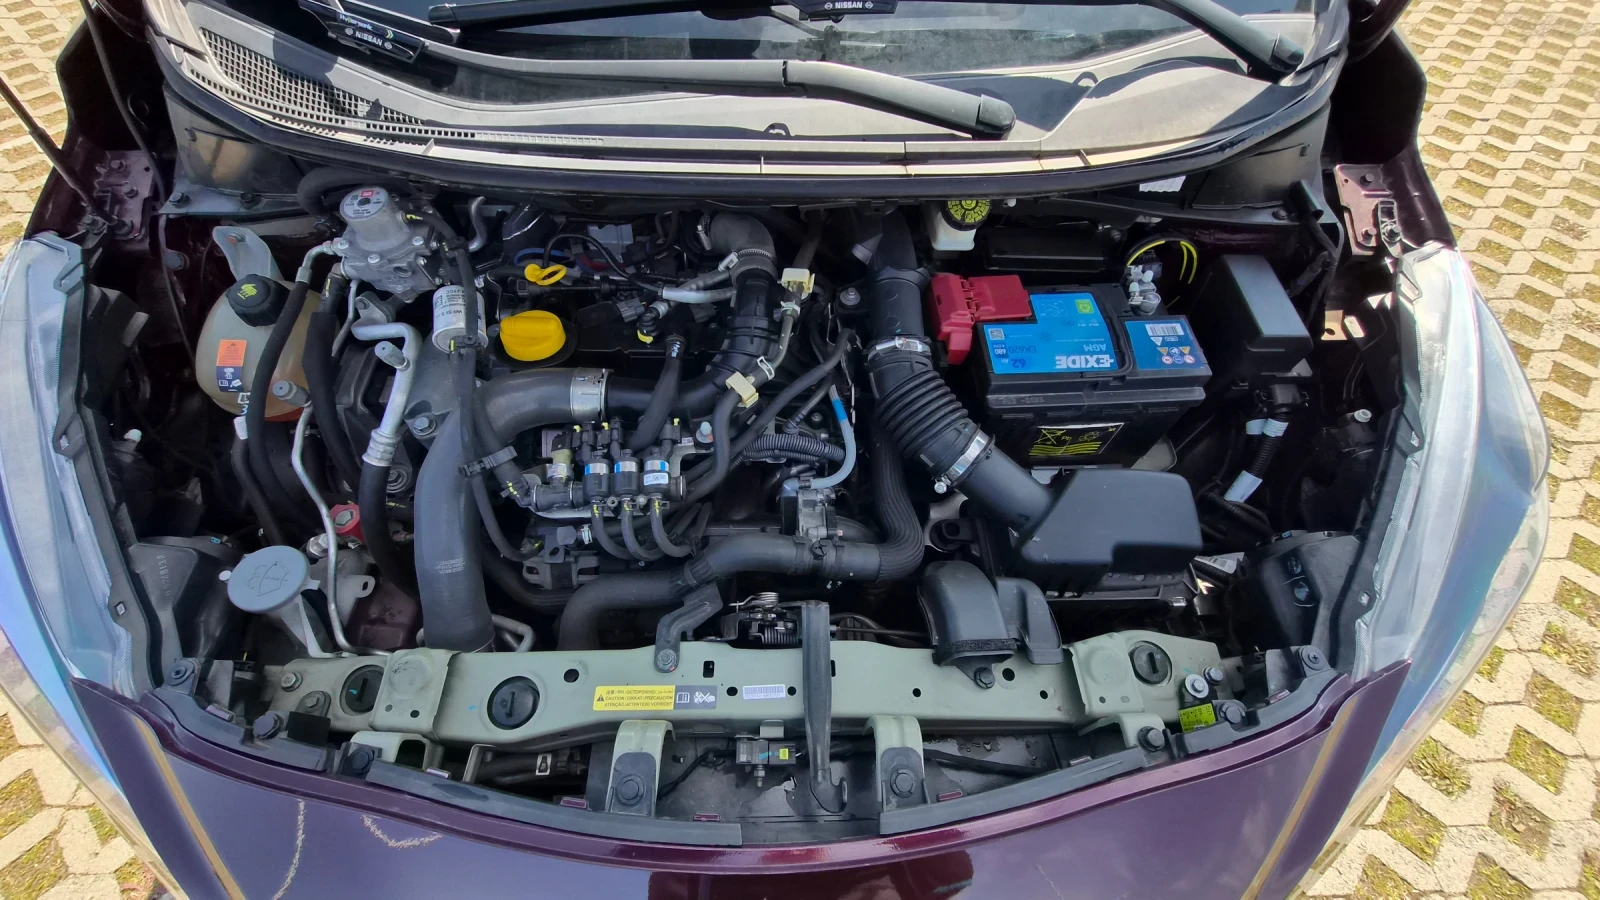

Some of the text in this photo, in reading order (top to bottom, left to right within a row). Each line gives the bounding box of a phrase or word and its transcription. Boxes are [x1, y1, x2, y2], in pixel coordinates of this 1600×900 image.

[835, 1, 863, 9] NISSAN
[355, 31, 383, 46] NISSAN
[1008, 345, 1037, 354] EK620
[1083, 343, 1107, 352] AGM
[1011, 358, 1027, 368] 62
[1055, 354, 1114, 369] EXIDE
